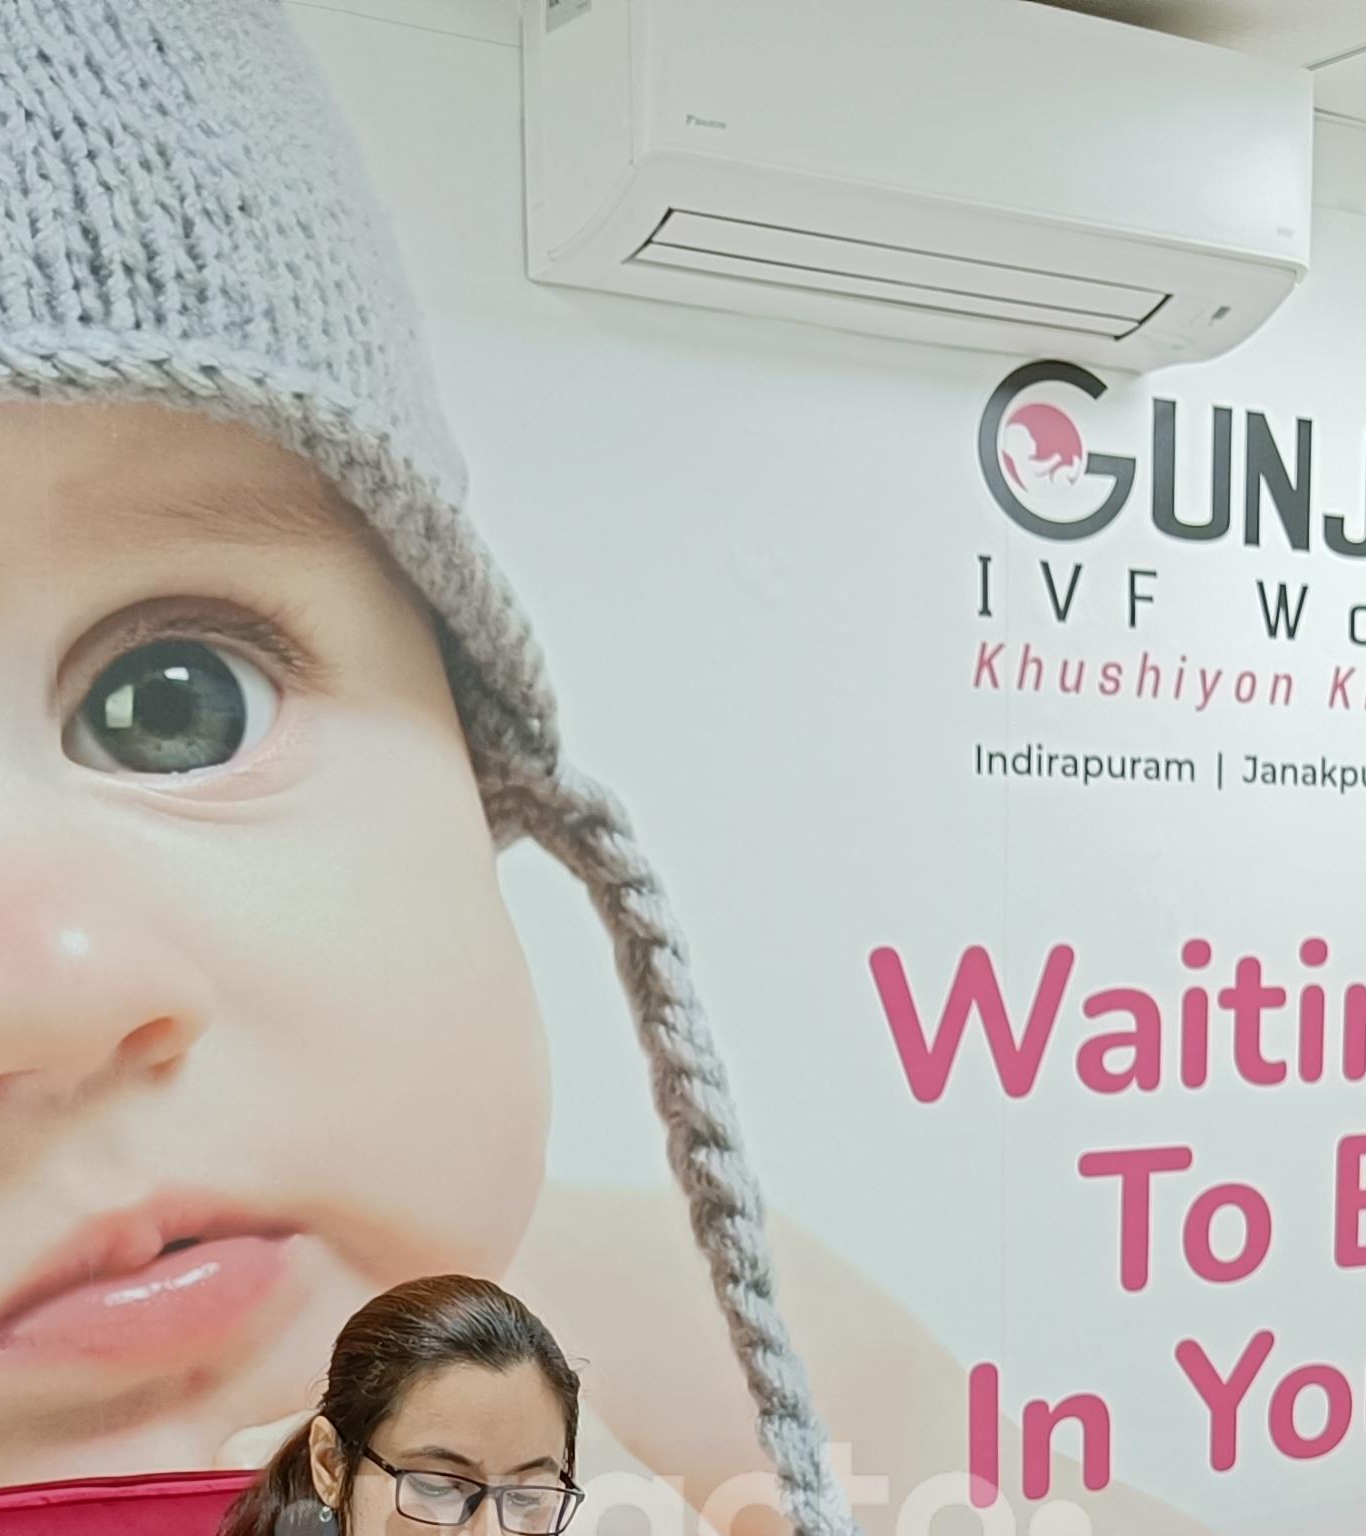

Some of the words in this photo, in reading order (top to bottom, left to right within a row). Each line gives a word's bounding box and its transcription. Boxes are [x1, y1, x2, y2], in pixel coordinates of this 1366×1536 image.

[972, 642, 1296, 711] Khushiyon
[976, 743, 1196, 786] Indirapuram
[1078, 1146, 1273, 1291] To
[968, 1362, 1111, 1509] In
